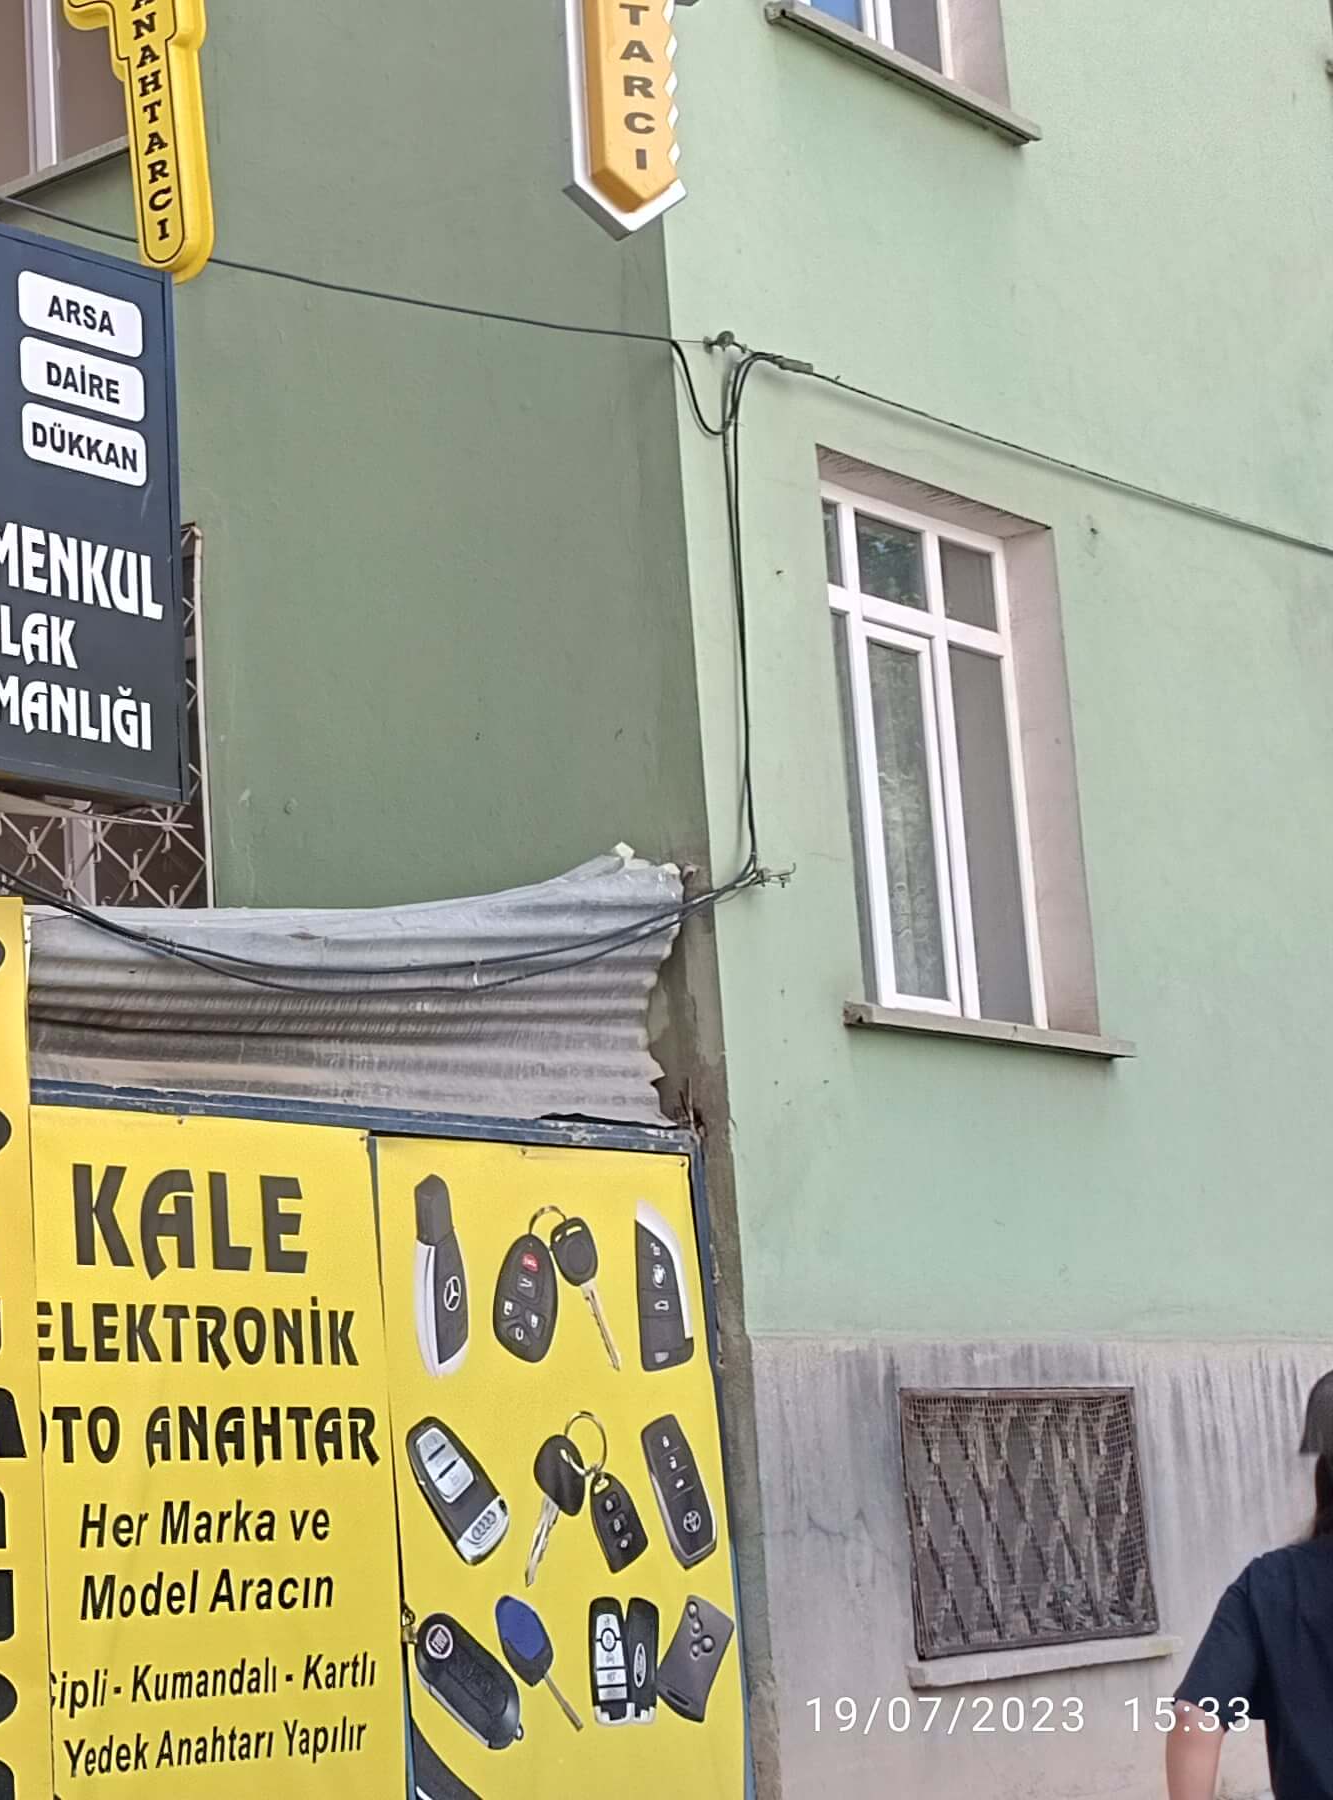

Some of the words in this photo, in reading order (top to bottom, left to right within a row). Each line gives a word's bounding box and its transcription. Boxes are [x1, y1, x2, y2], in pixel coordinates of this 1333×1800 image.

[619, 3, 655, 171] TARCI
[47, 295, 115, 337] ARSA
[45, 360, 120, 405] DAİRE
[31, 420, 138, 474] DÜKKAN
[72, 1163, 308, 1280] KALE
[36, 1296, 359, 1371] ELEKTRONİK
[40, 1405, 121, 1464] TO
[145, 1405, 380, 1469] ANAHTAR
[79, 1503, 149, 1548] Her
[160, 1499, 277, 1545] Marka
[290, 1507, 330, 1541] ve
[80, 1569, 199, 1621] Model
[209, 1568, 334, 1613] Aracın
[132, 1656, 277, 1703] Kumandalı
[303, 1651, 377, 1691] Kartlı
[64, 1732, 149, 1777] Yedek
[155, 1725, 274, 1769] Anahtarı
[283, 1715, 367, 1764] Yapılır
